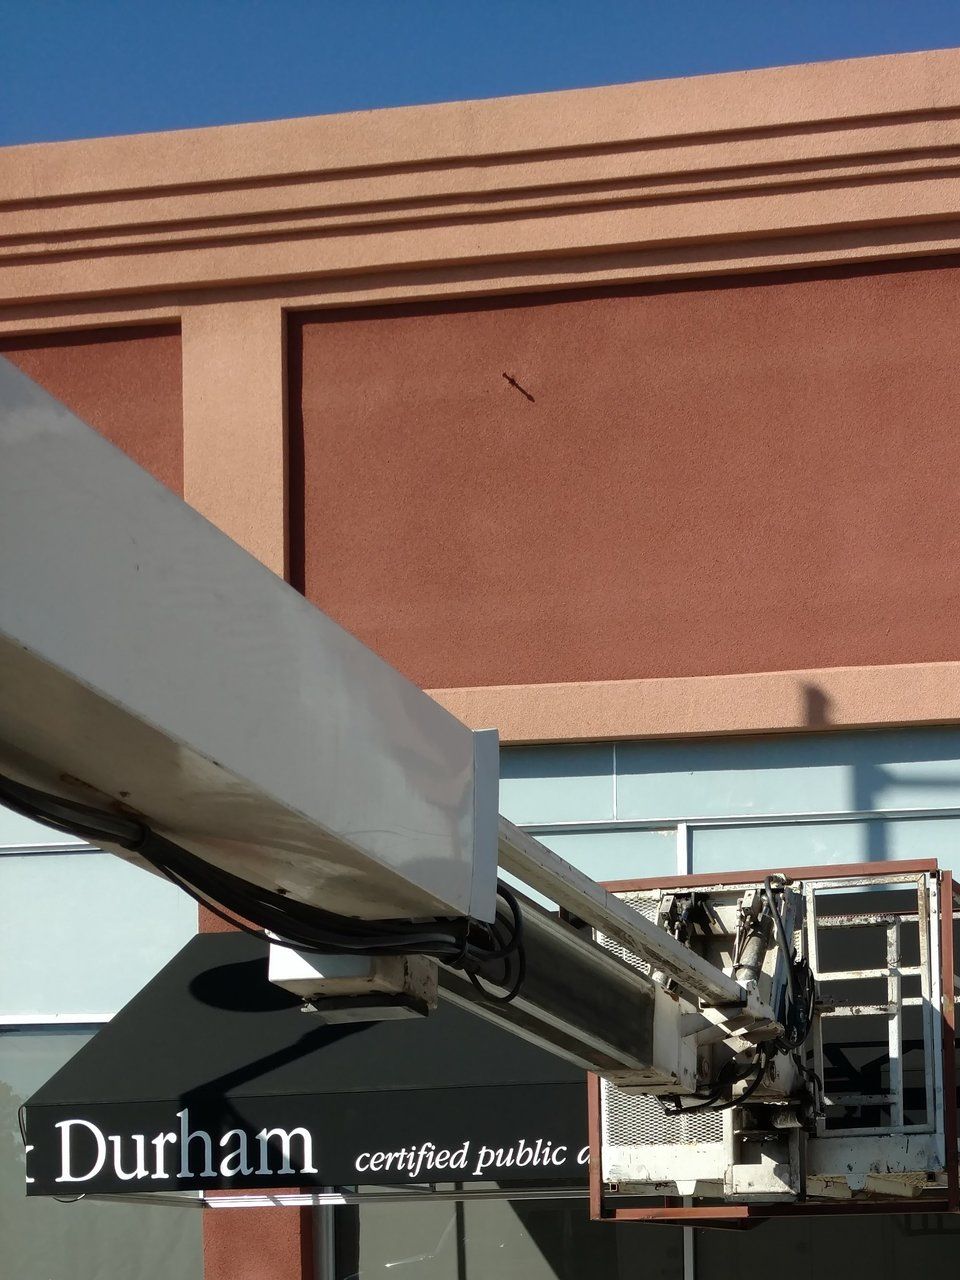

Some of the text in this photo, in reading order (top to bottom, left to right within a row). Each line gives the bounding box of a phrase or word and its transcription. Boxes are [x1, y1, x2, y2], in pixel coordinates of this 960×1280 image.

[54, 1107, 319, 1183] Durham
[354, 1140, 470, 1178] certified
[472, 1138, 568, 1176] public
